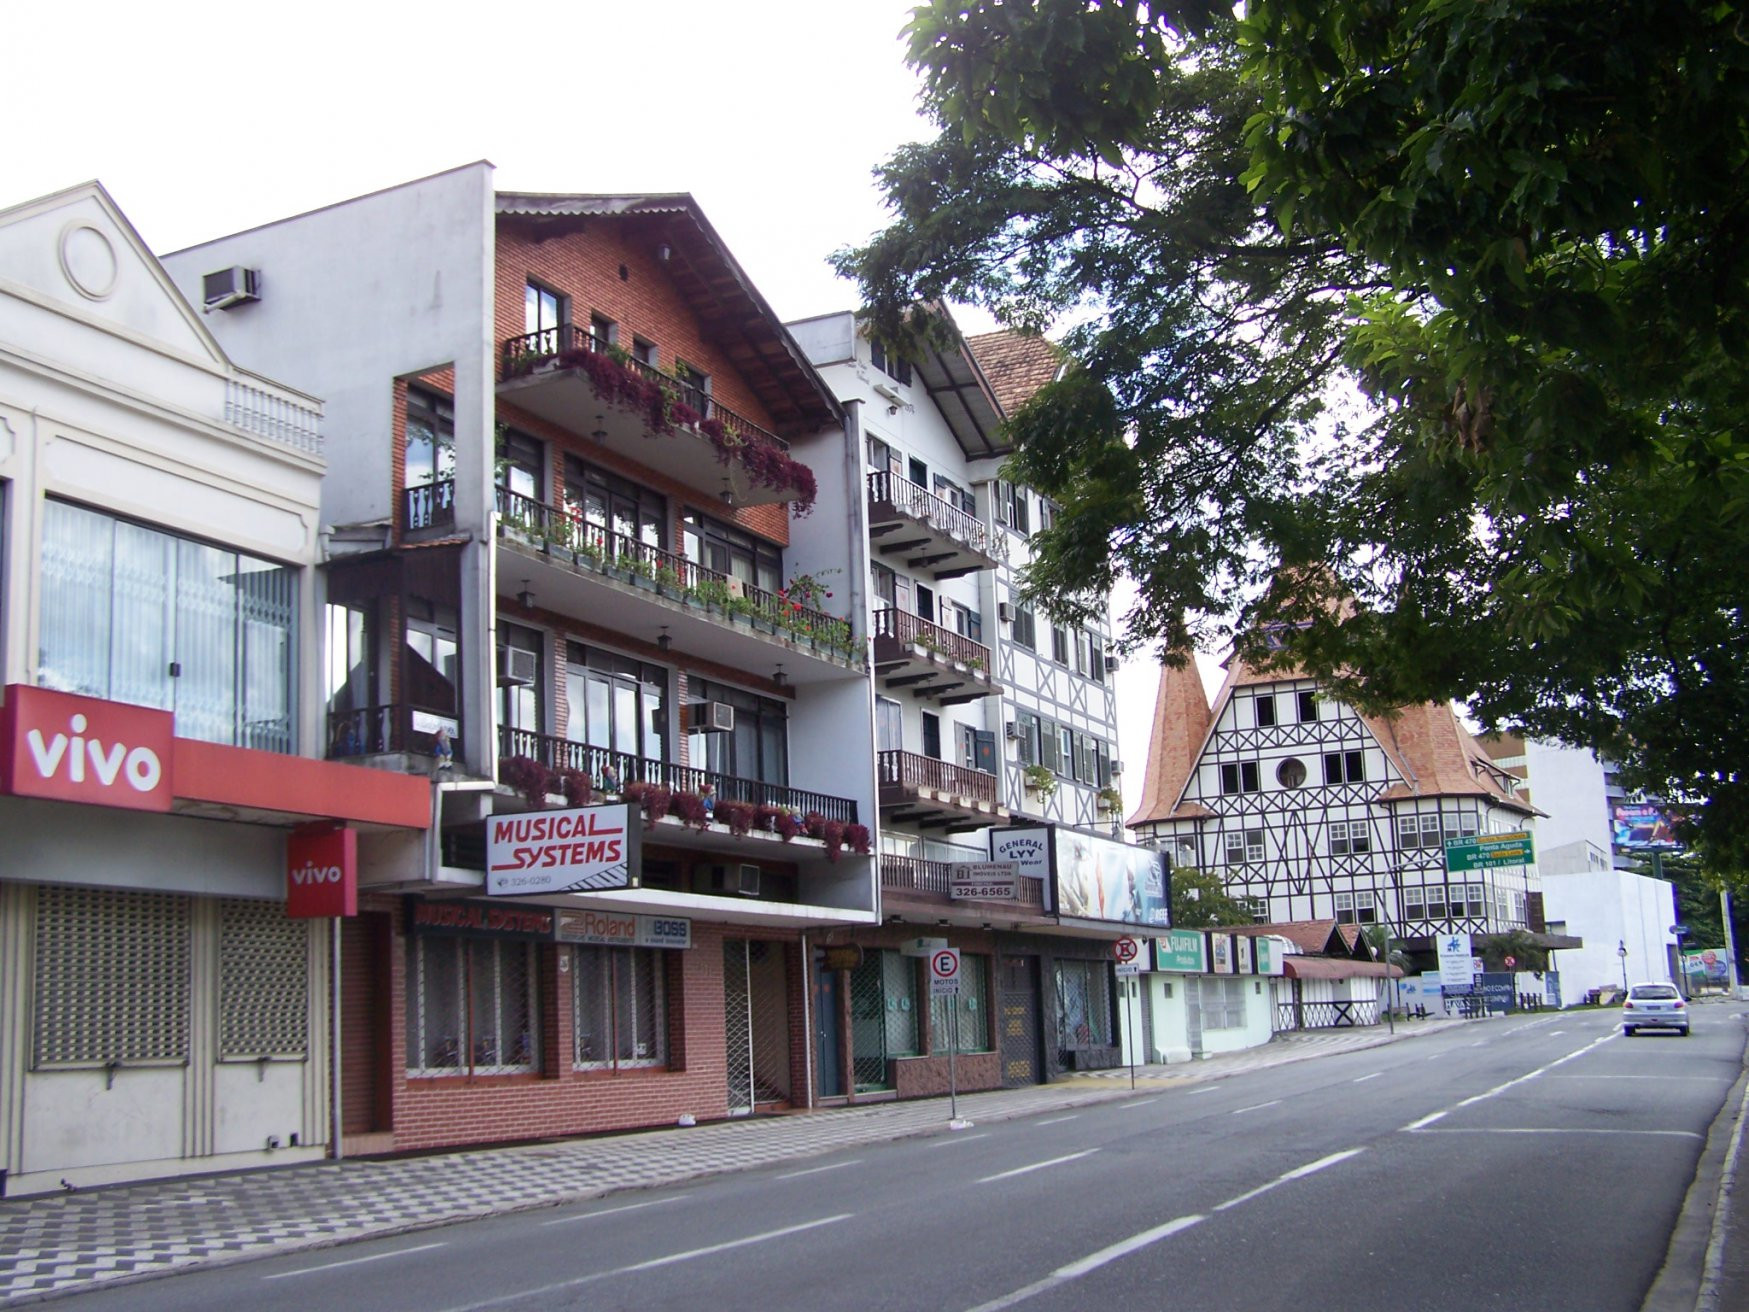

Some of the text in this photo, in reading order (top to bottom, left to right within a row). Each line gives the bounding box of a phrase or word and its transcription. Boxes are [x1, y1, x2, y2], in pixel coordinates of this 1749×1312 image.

[28, 714, 161, 791] vivo
[494, 813, 623, 844] MUSICAL
[491, 840, 621, 871] SYSTEMS
[999, 839, 1044, 853] GENERAL
[1009, 849, 1035, 859] LYY
[292, 861, 342, 885] vivo
[956, 887, 1010, 896] 326-6565
[416, 904, 551, 934] MUSICAL SYSTEMS
[584, 913, 635, 937] Roland
[654, 920, 687, 937] BOSS
[1170, 937, 1198, 953] FUJIFILM
[941, 956, 950, 972] E
